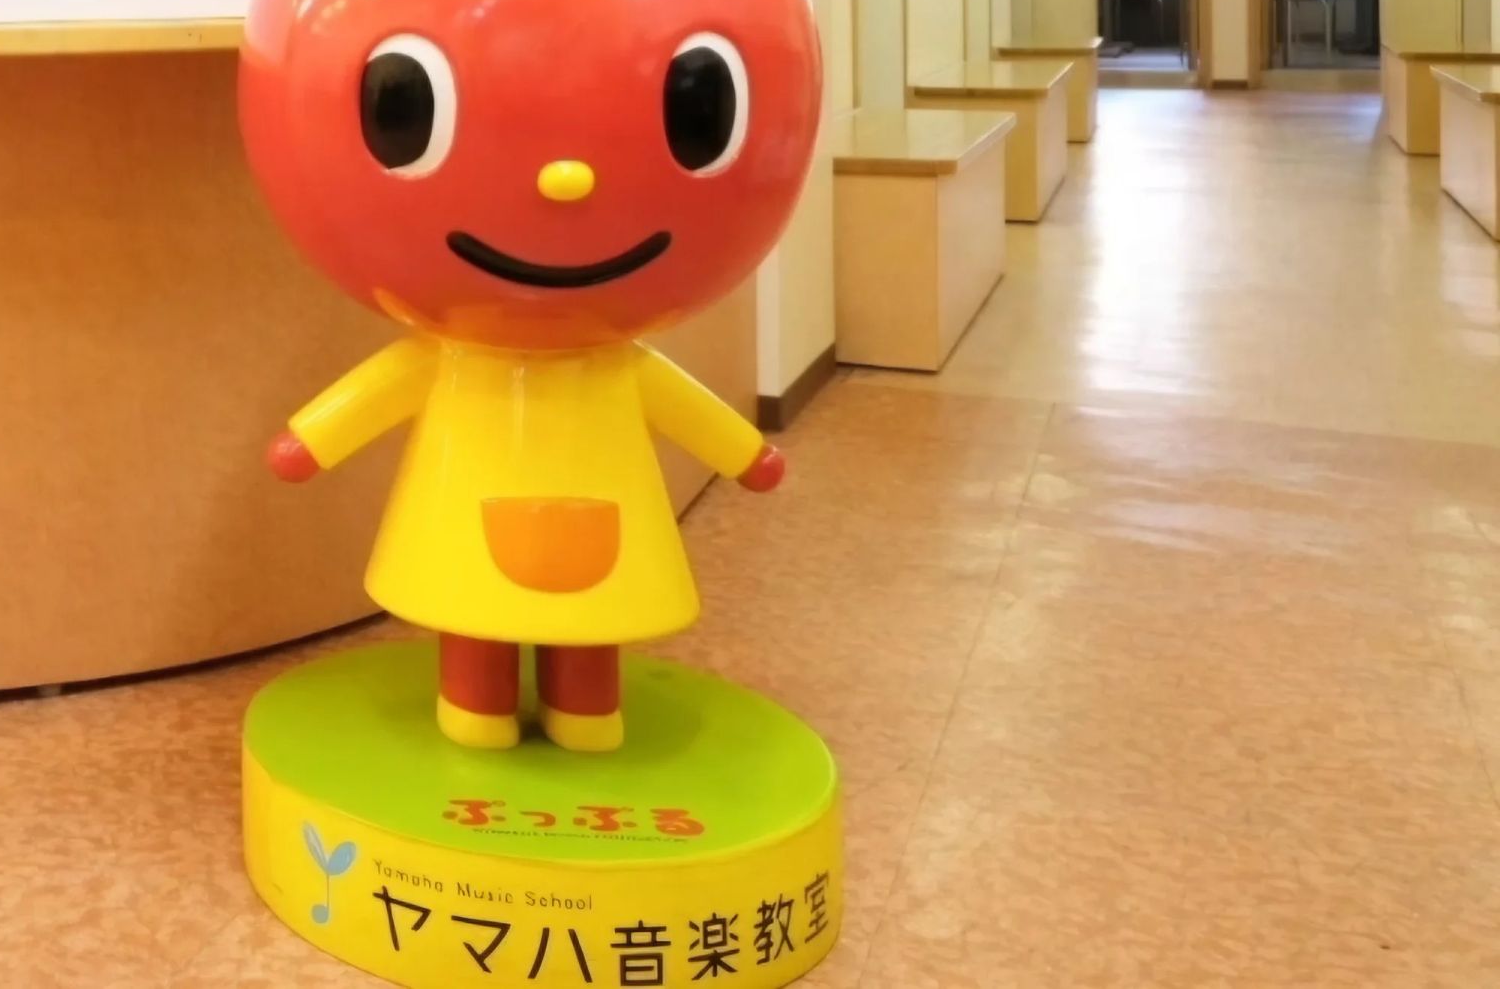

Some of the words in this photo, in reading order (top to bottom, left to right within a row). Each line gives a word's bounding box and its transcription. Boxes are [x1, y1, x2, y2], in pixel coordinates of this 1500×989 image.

[373, 859, 443, 892] Yamaha
[457, 881, 513, 904] Music
[525, 890, 593, 911] School
[372, 870, 829, 987] ヤマハ音楽教室
